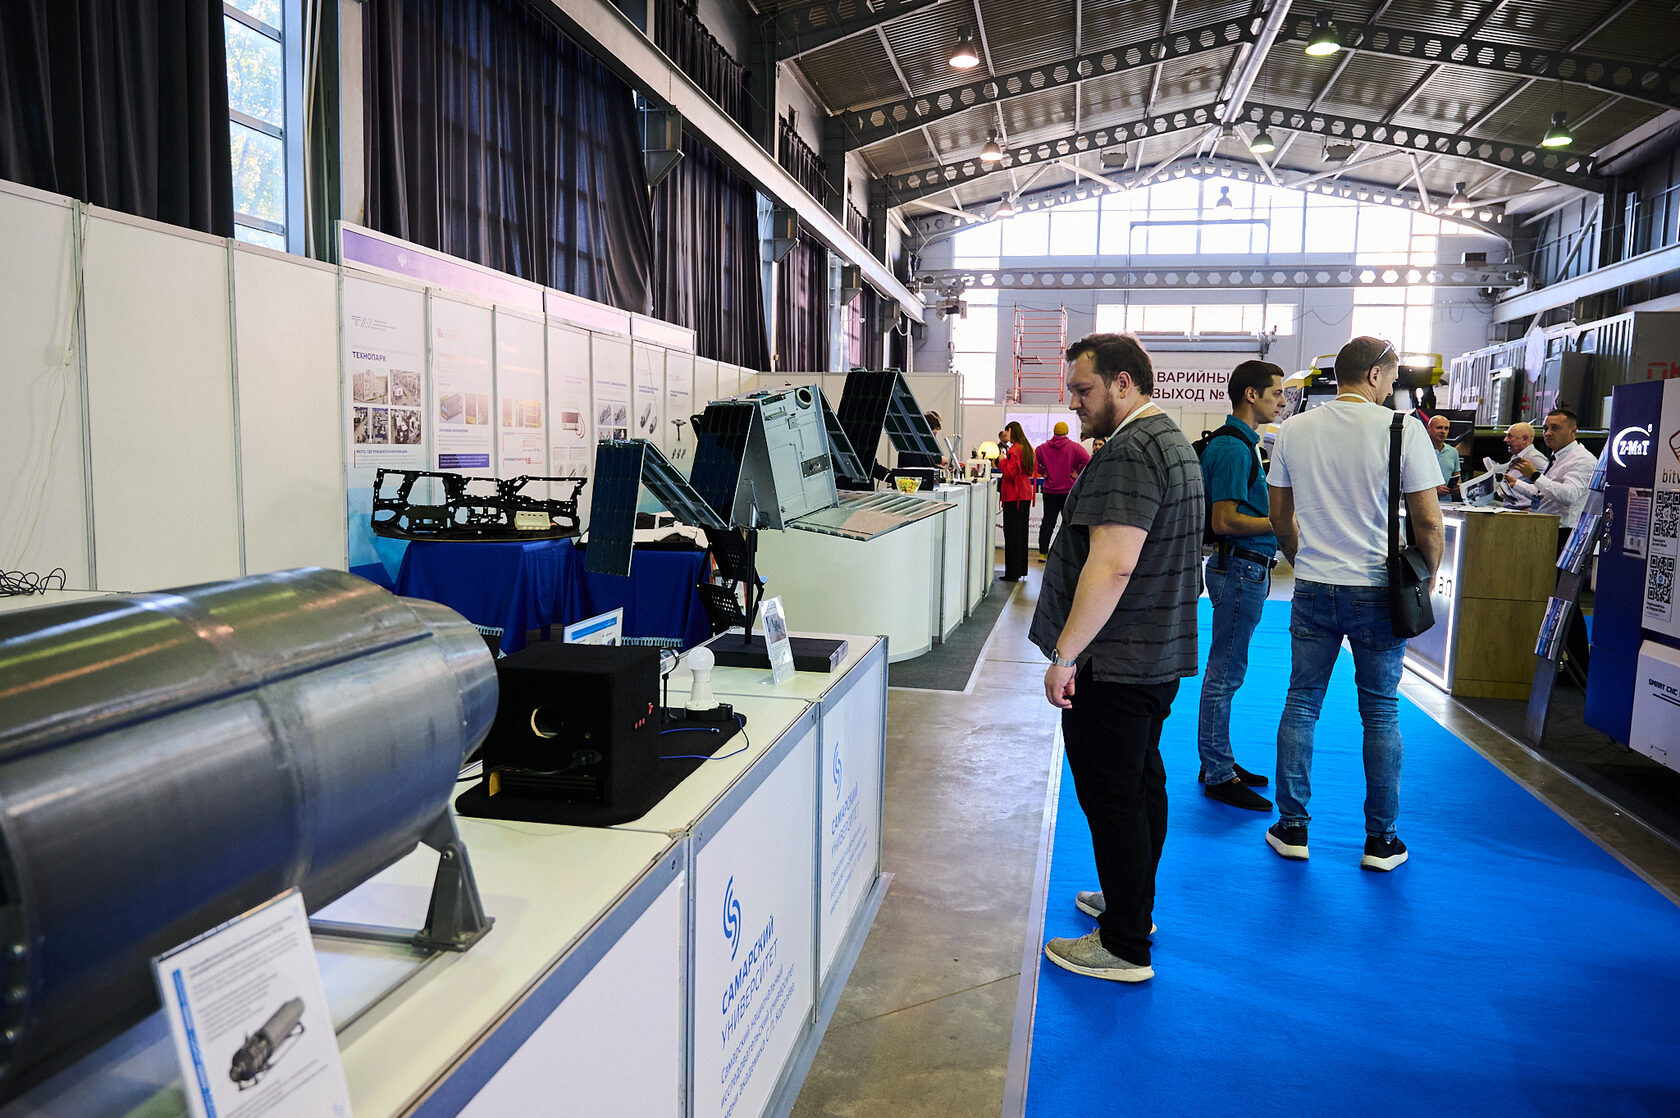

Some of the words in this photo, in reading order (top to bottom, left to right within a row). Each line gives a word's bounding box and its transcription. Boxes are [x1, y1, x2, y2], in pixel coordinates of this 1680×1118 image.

[352, 351, 387, 362] ТЕХНОПАРК
[1154, 369, 1230, 383] ВАРИЙНЫ
[1152, 388, 1205, 401] ВЫХОД
[1209, 388, 1225, 399] №
[1439, 576, 1453, 598] an
[1647, 678, 1667, 691] SMART
[722, 913, 774, 1015] САМАРСКИЙ
[721, 937, 779, 1050] УНИВЕРСИТЕТ
[721, 1023, 750, 1085] Самарский
